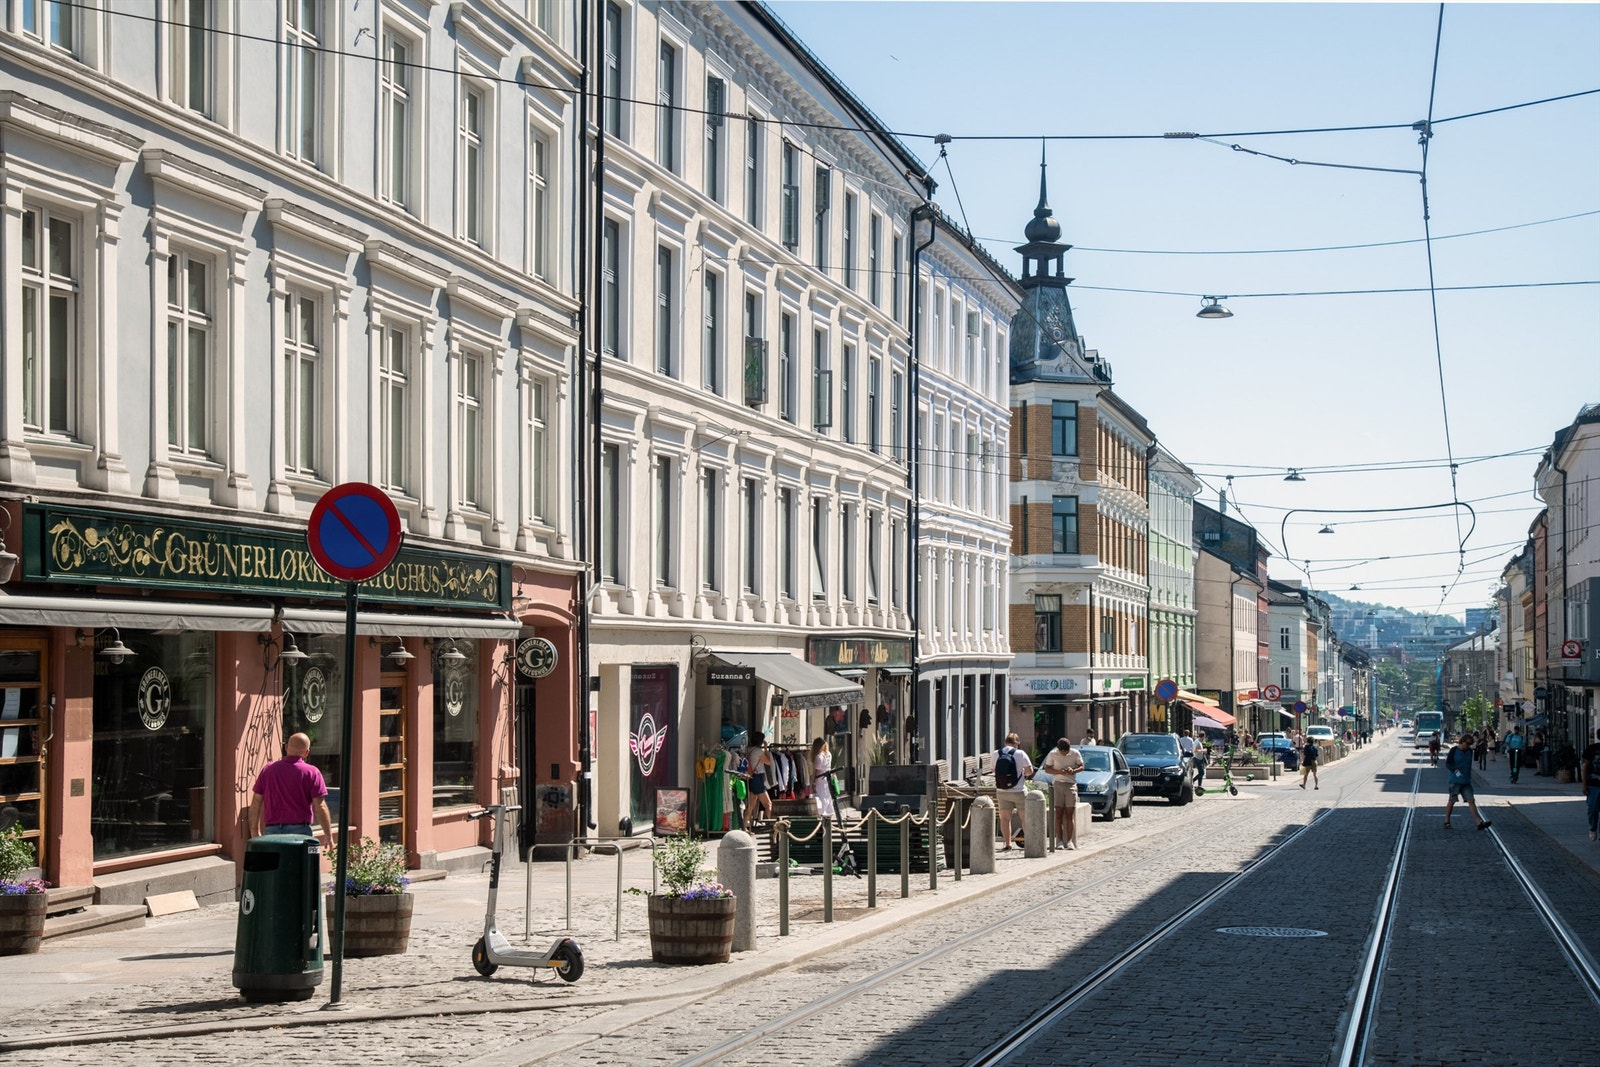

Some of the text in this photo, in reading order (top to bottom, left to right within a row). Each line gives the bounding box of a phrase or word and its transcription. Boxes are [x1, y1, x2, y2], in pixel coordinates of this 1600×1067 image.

[165, 532, 341, 585] GRÜNERLØKK
[525, 648, 544, 668] G
[146, 684, 162, 714] G
[308, 682, 320, 709] G
